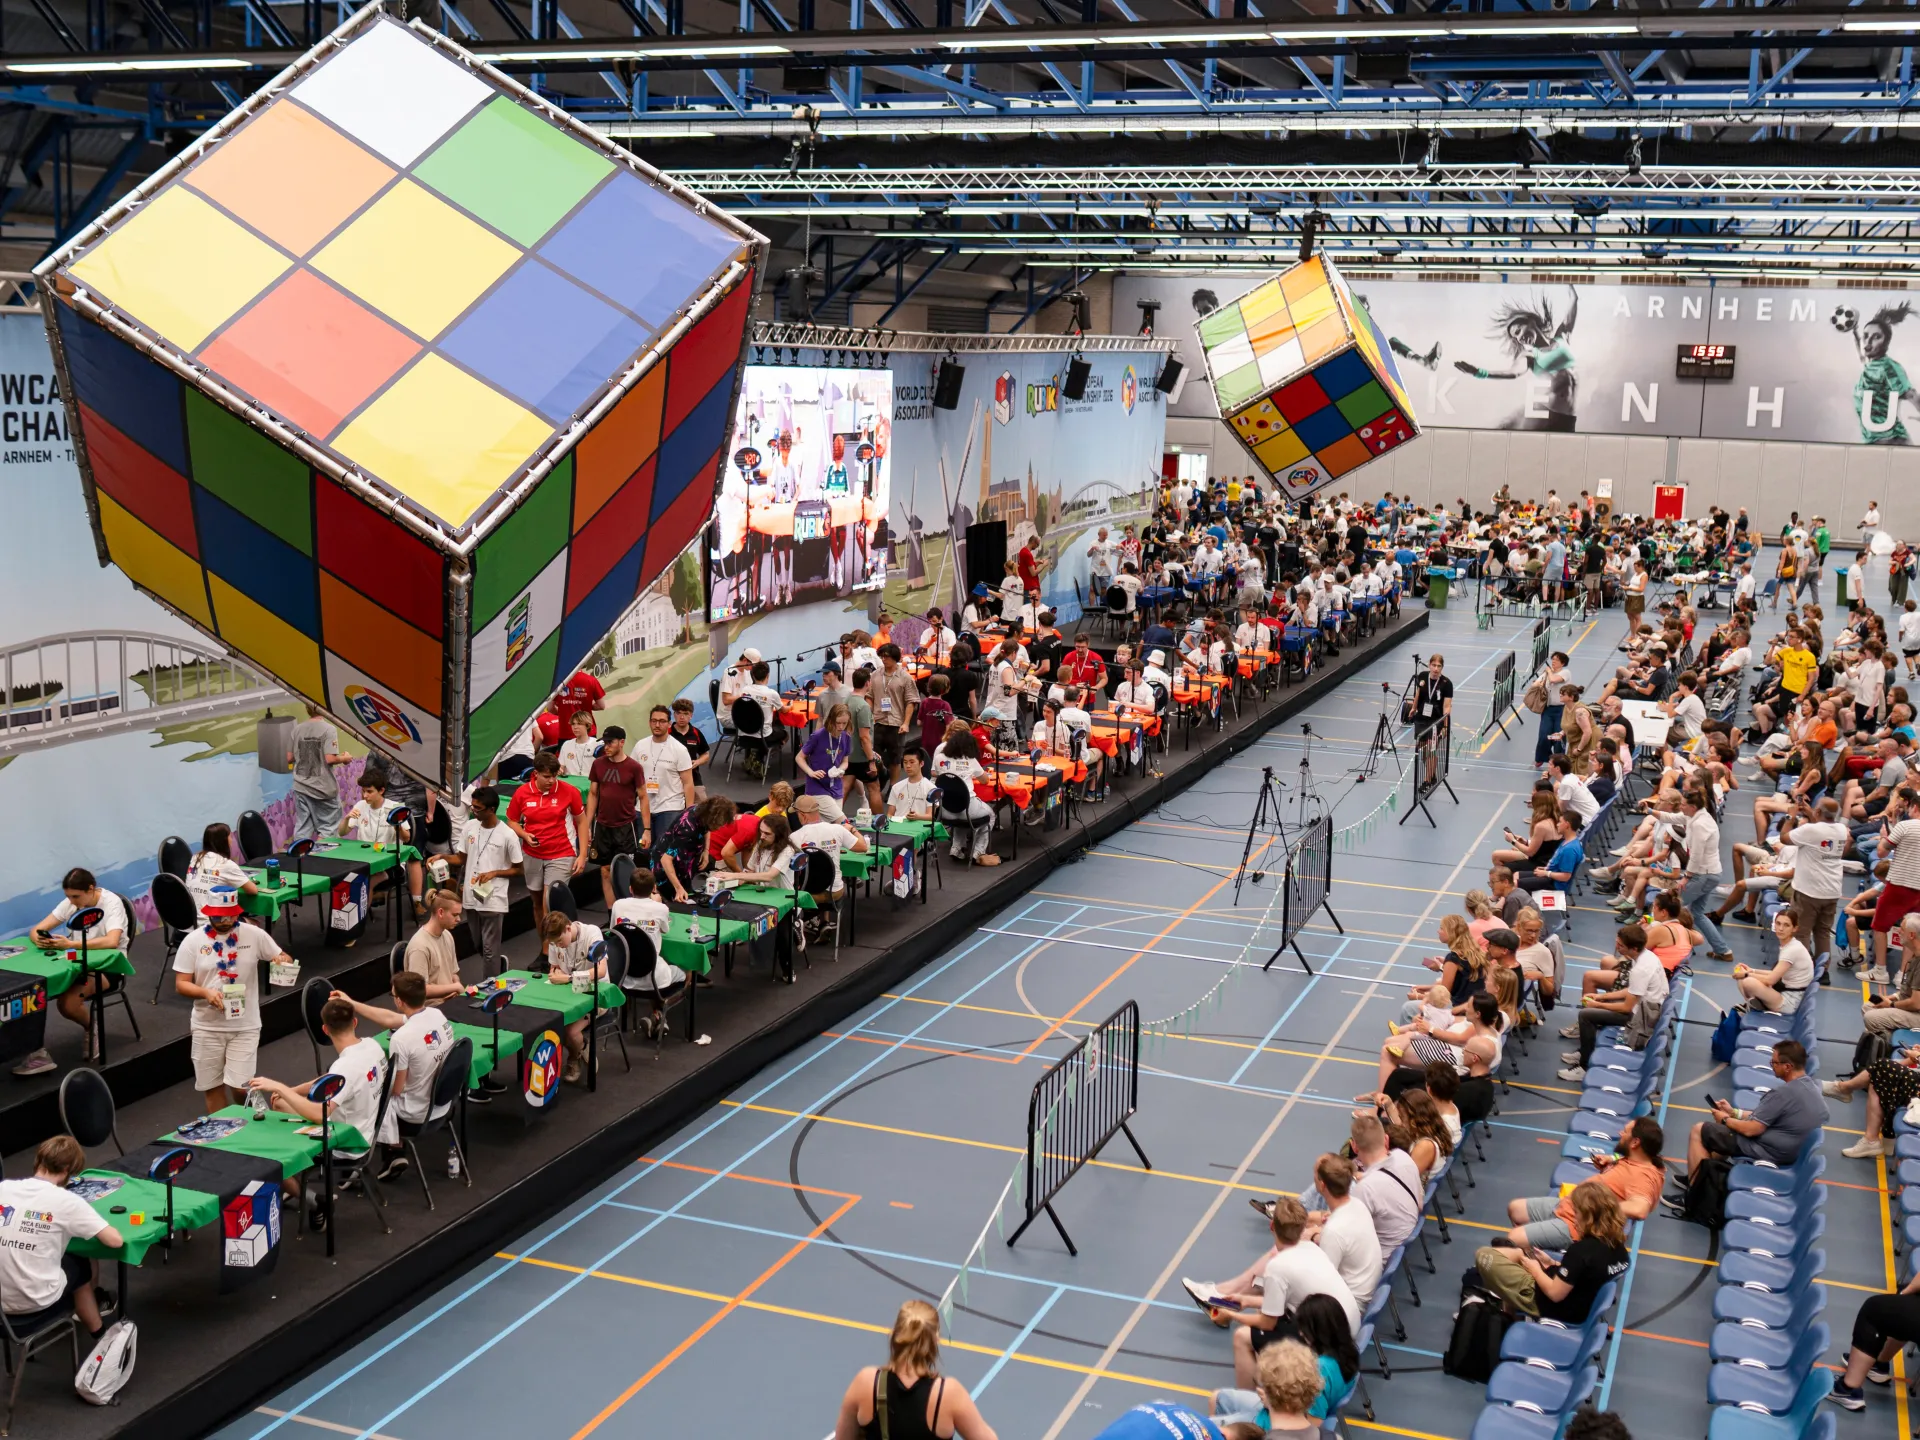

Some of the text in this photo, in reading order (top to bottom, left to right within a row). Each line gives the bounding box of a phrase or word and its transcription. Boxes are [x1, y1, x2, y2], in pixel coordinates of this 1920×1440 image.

[1613, 295, 1816, 322] ARNHEM
[3, 411, 69, 442] CHA
[3, 450, 52, 464] ARNHEM
[0, 984, 47, 1022] UBIK'S
[532, 1045, 557, 1091] WCA
[21, 1219, 52, 1230] WCA EURO
